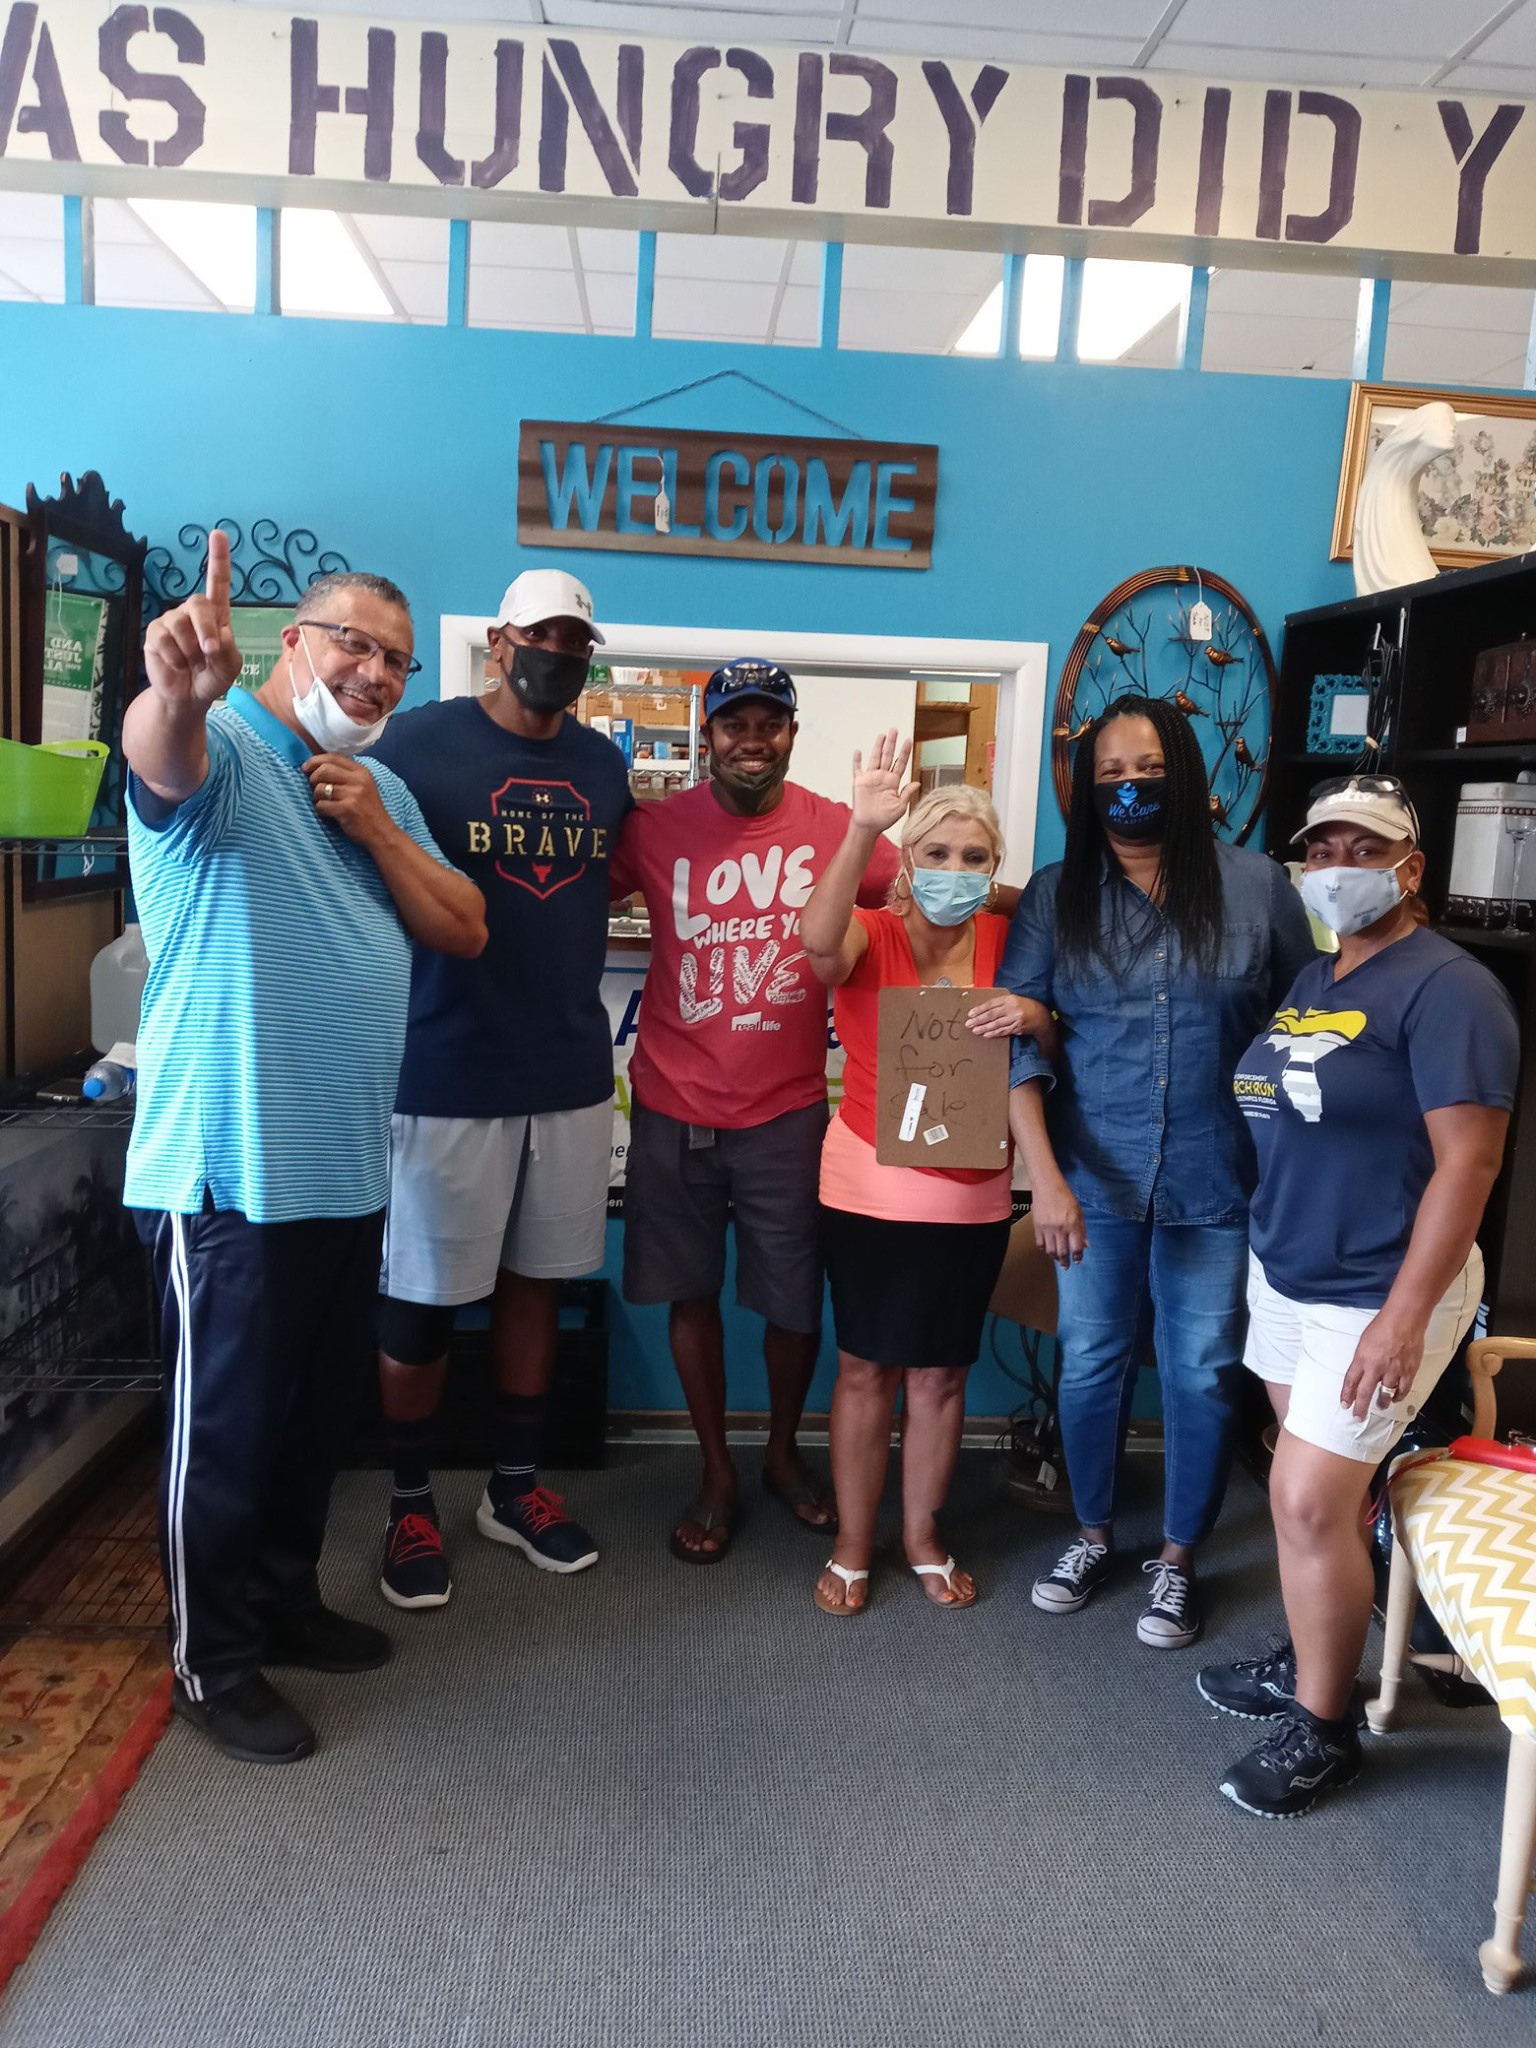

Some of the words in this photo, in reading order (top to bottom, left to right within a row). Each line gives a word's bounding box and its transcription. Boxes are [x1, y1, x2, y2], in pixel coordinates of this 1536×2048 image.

[0, 2, 207, 167] AS
[288, 17, 1009, 216] HUNGRY
[1057, 74, 1362, 243] DID
[1437, 100, 1525, 255] Y
[540, 440, 918, 551] WELCOME
[501, 809, 532, 819] HOME
[541, 812, 554, 820] OF
[565, 813, 584, 822] THE
[1109, 803, 1126, 818] We
[1129, 801, 1161, 818] Care
[467, 821, 607, 858] BRAVE
[672, 845, 816, 941] LOVE
[694, 914, 775, 949] WHERE
[679, 939, 807, 1025] LIVE
[735, 1019, 760, 1031] real
[762, 1020, 781, 1031] life
[900, 1009, 961, 1041] Not
